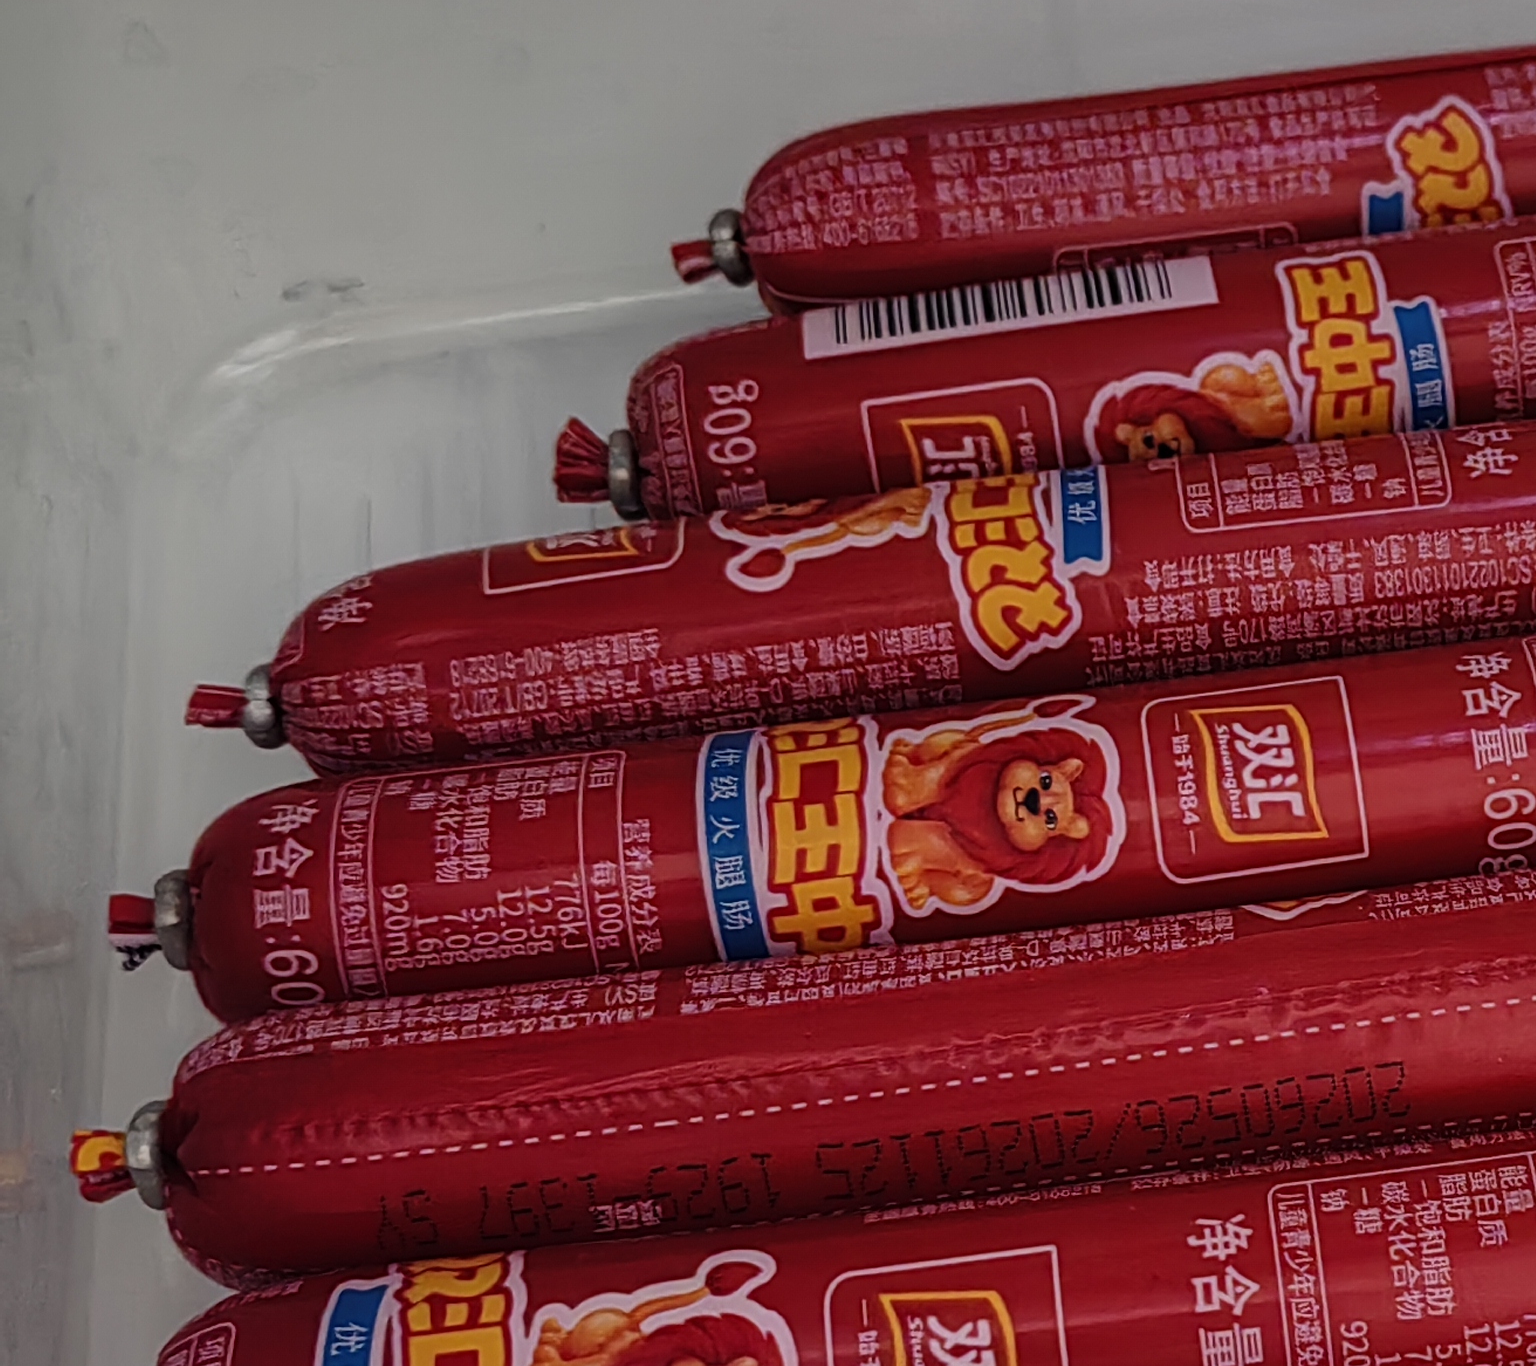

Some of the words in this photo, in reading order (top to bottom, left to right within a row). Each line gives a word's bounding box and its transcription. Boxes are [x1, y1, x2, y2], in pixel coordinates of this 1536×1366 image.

[1288, 261, 1394, 437] 王中王
[944, 473, 1069, 651] 双汇
[1232, 722, 1305, 820] 双汇
[709, 748, 754, 930] 优级火腿肠
[767, 718, 876, 954] 汇王中
[381, 883, 413, 971] 920mg
[413, 914, 444, 968] 1.6g
[441, 909, 471, 965] 7.0g
[469, 907, 499, 962] 5.0g
[497, 889, 525, 959] 12.0g
[523, 885, 555, 955] 12.5g
[554, 875, 584, 950] 776kJ
[1319, 1188, 1349, 1213] 钠
[1437, 1173, 1471, 1223] 脂肪
[1467, 1169, 1509, 1248] 蛋白质
[1497, 1166, 1534, 1214] 能量
[1379, 1181, 1426, 1321] 碳水化合物
